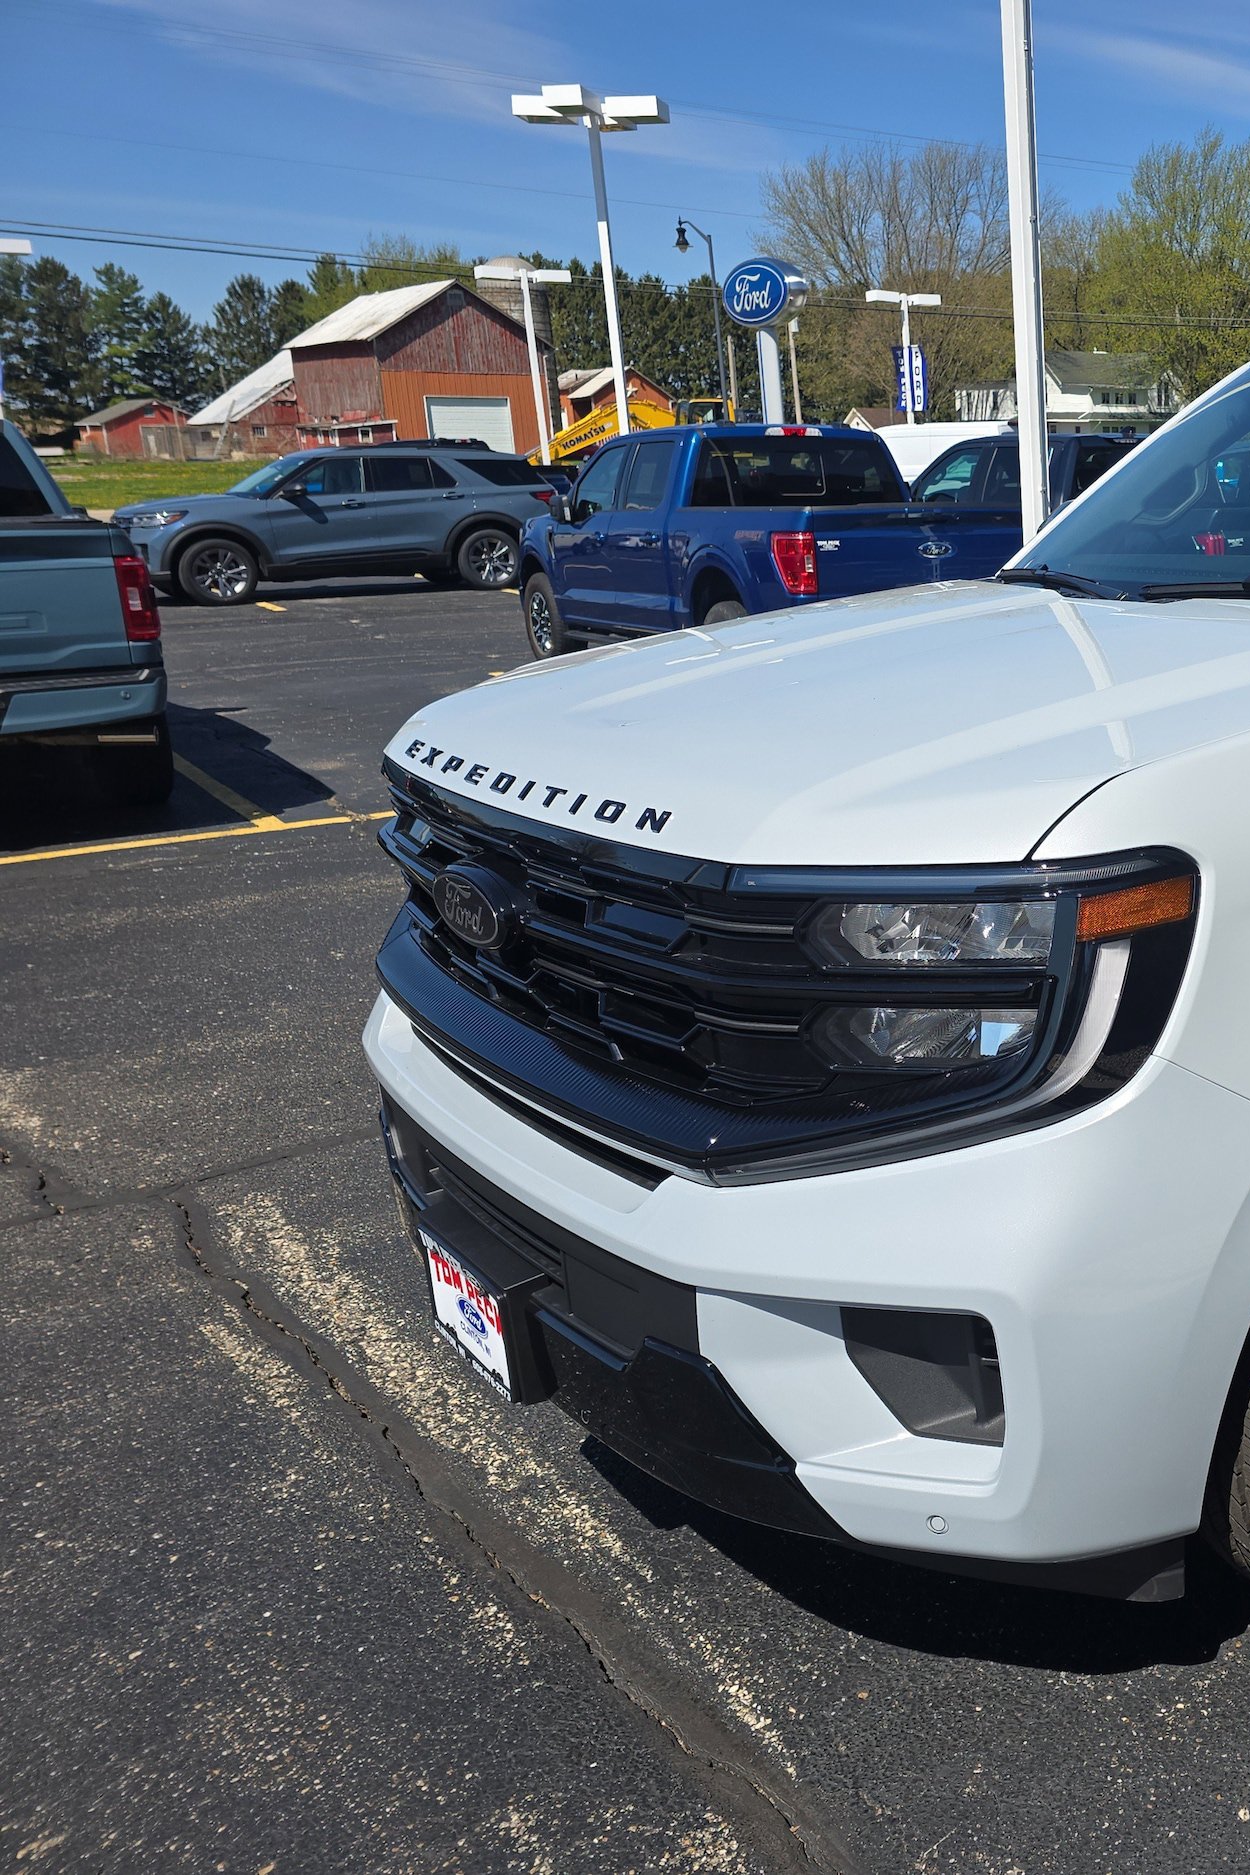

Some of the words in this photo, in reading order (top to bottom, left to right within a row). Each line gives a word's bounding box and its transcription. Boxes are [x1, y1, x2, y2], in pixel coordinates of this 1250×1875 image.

[733, 273, 772, 313] Ford
[914, 350, 922, 405] FORD
[562, 425, 606, 450] KOMATSU
[926, 544, 946, 555] Ford
[404, 739, 673, 834] EXPEDITION
[444, 880, 484, 936] Ford
[430, 1250, 464, 1295] TOM
[463, 1302, 482, 1331] Ford
